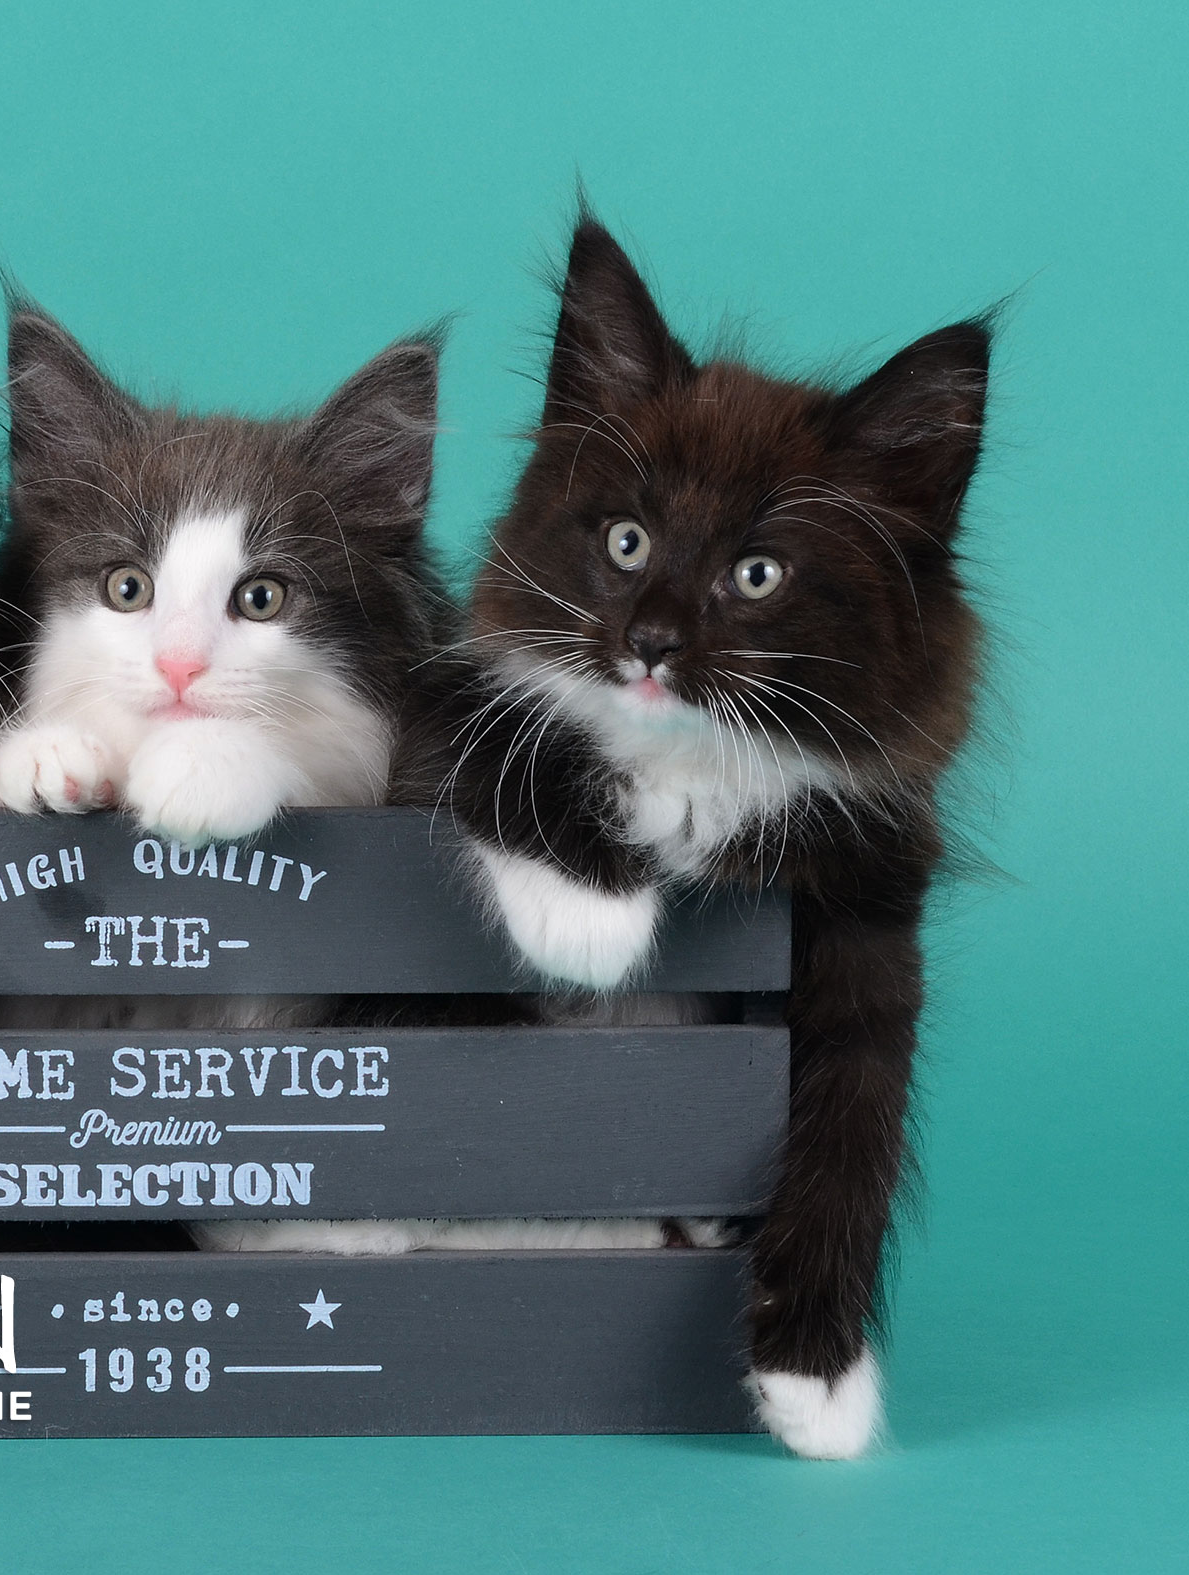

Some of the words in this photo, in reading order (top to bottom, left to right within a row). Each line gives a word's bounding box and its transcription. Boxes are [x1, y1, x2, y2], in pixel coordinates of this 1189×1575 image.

[133, 838, 327, 901] QUALITY
[111, 1046, 389, 1099] SERVICE
[70, 1109, 221, 1148] Premium
[84, 1292, 212, 1322] since
[79, 1347, 210, 1392] 1938
